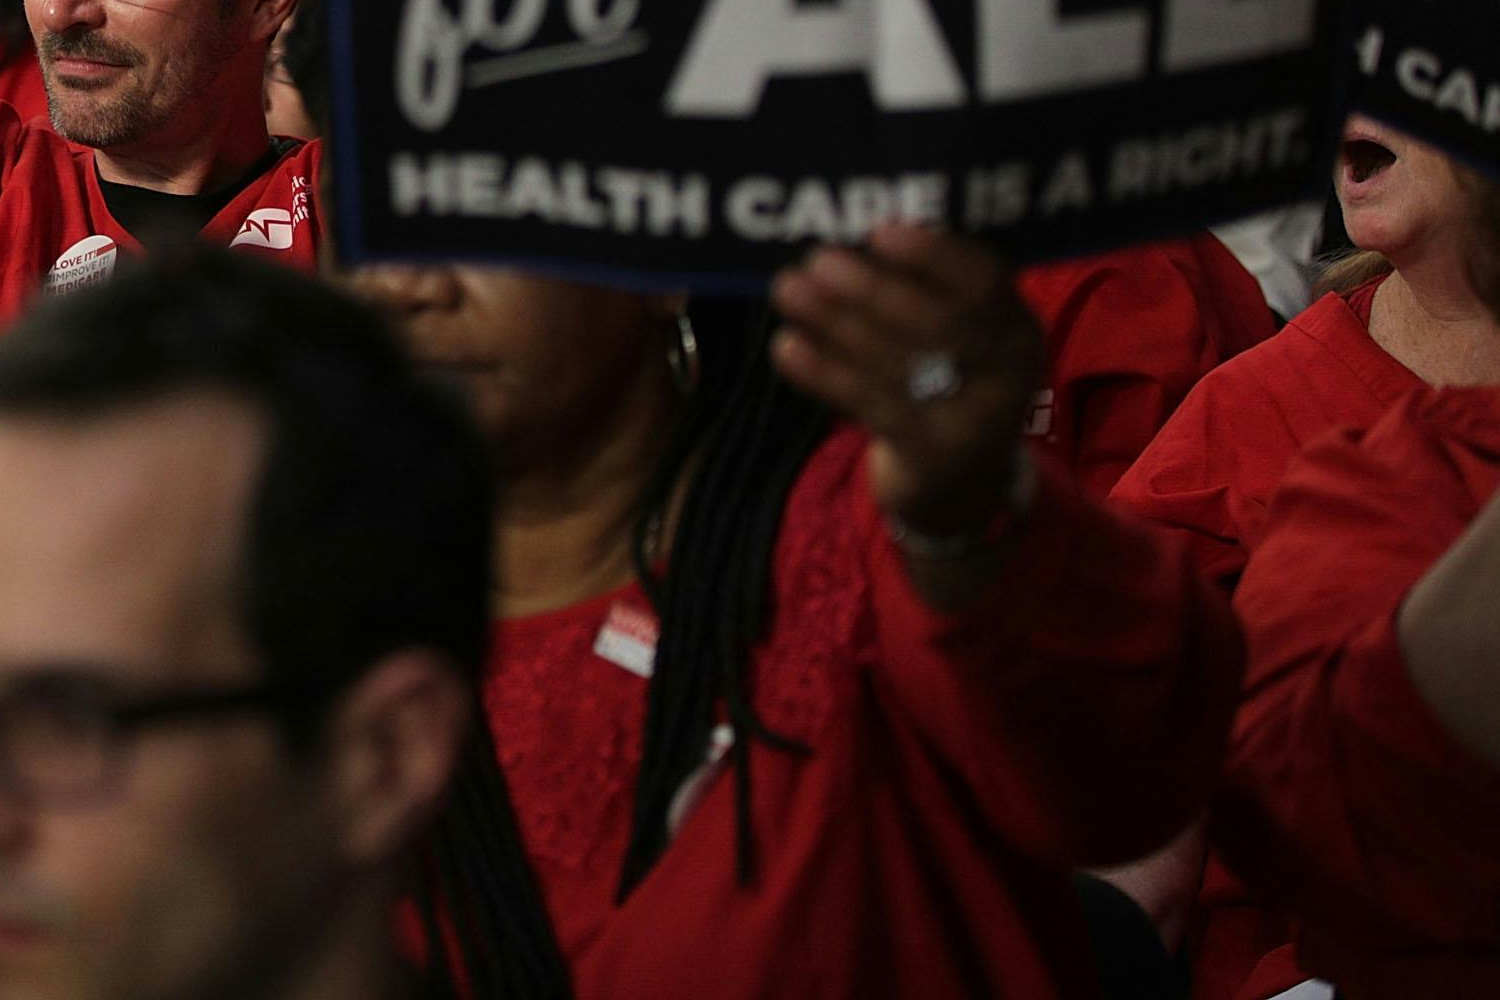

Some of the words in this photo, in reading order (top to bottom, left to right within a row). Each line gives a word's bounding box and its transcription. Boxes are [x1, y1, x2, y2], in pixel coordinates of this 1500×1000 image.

[388, 148, 709, 239] HEALTH
[964, 163, 1031, 232] IS
[1041, 150, 1094, 212] A
[52, 261, 97, 282] IMPROVE
[53, 255, 82, 270] LOVE
